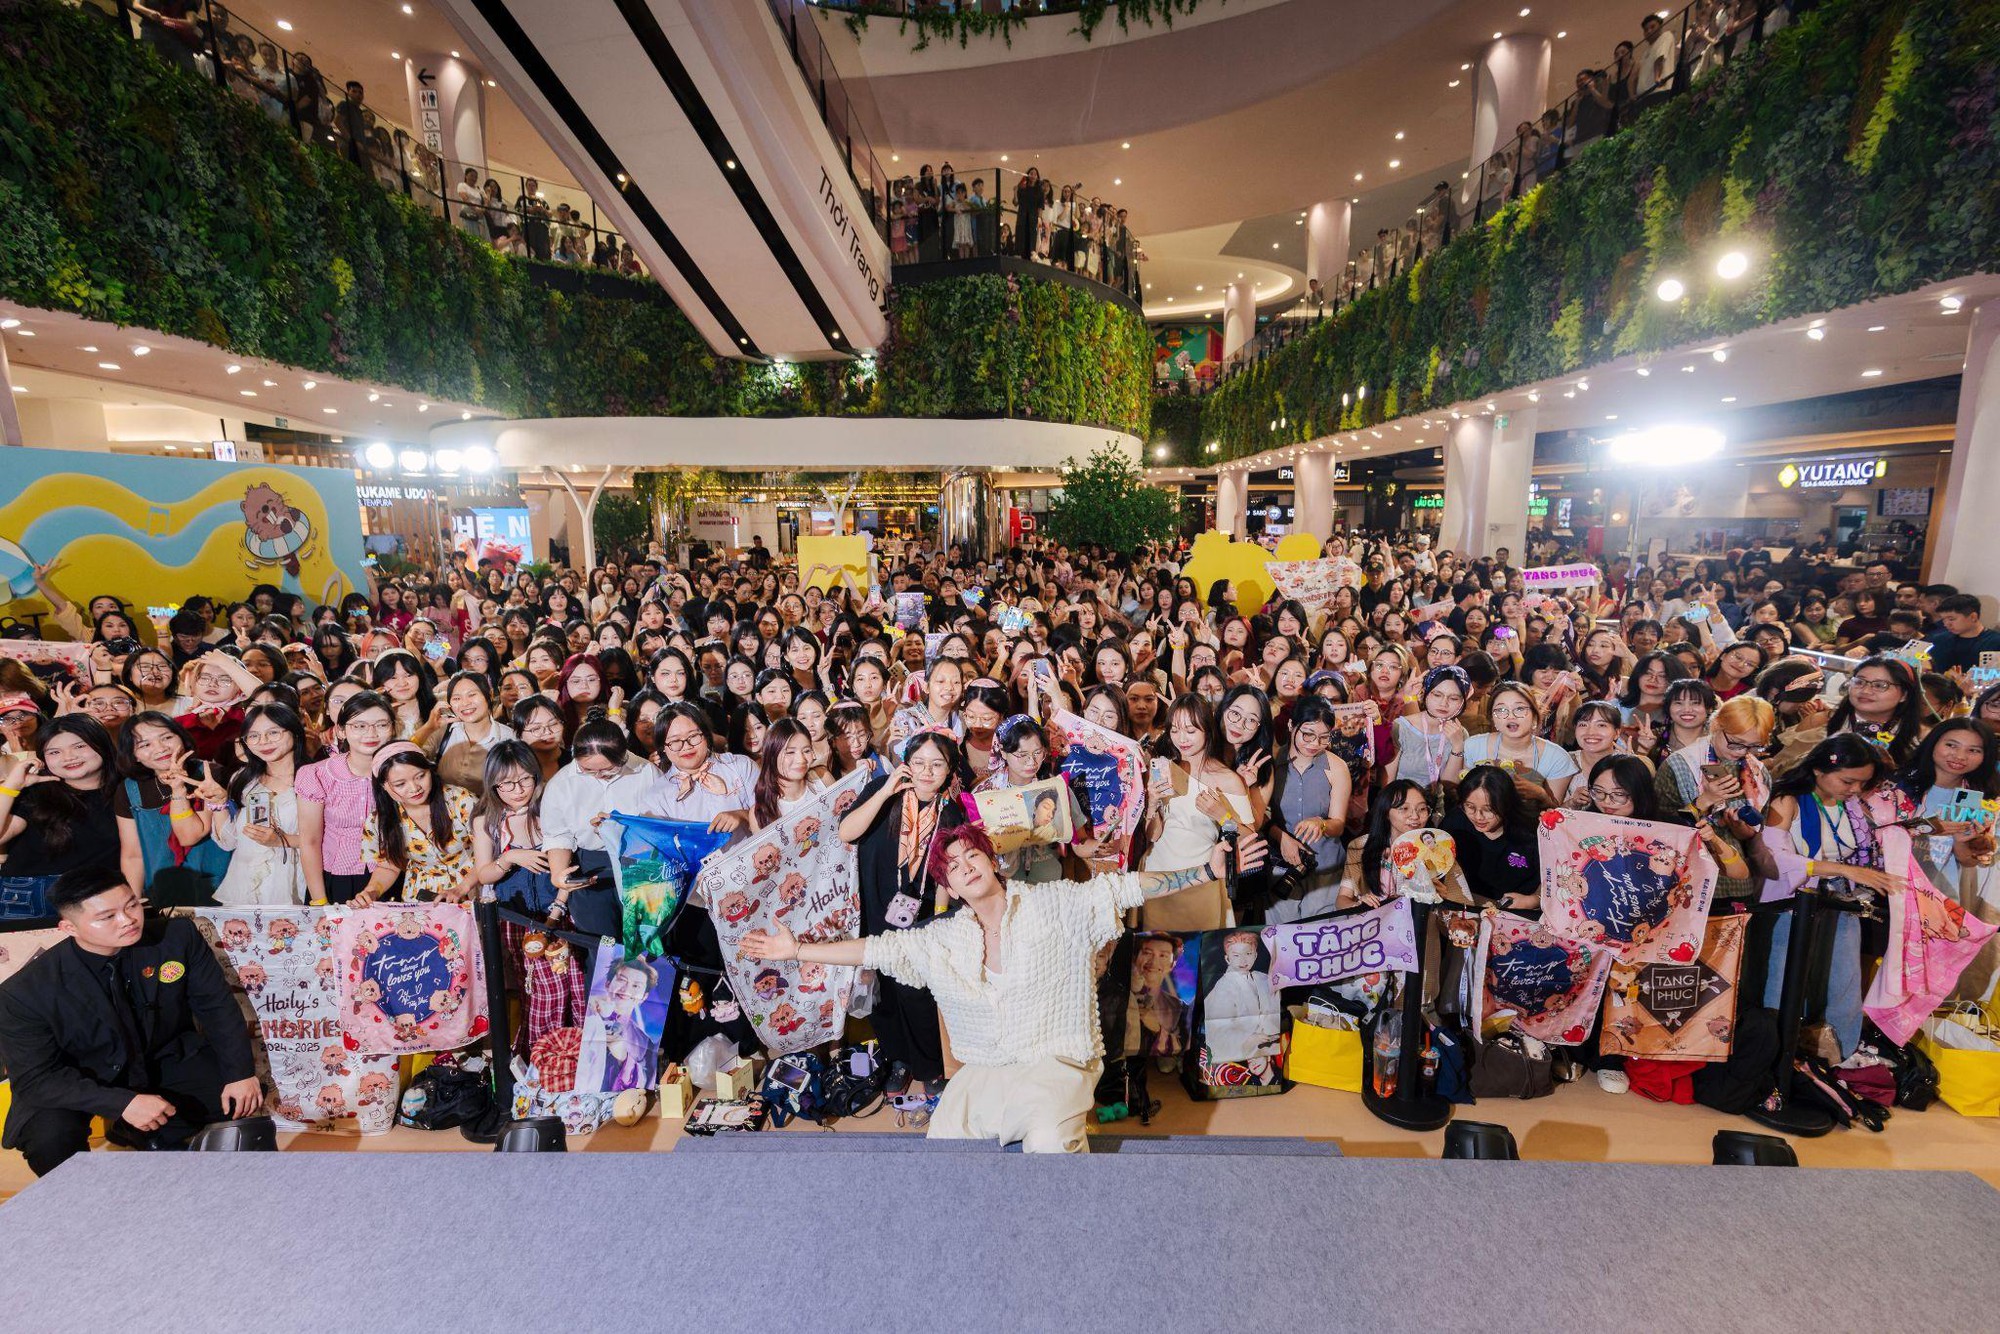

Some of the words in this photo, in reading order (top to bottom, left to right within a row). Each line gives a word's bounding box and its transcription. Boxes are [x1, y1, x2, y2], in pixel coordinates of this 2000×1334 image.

[819, 165, 849, 237] Thời
[849, 226, 880, 302] Trang
[1798, 461, 1876, 481] YUTANG
[1293, 917, 1381, 957] TĂNG
[1295, 940, 1386, 981] PHÚC
[387, 971, 413, 986] loves
[414, 965, 430, 979] you
[1510, 975, 1535, 986] loves
[1536, 973, 1554, 986] you
[1655, 975, 1695, 987] TANG
[257, 990, 319, 1018] Haily's
[1657, 989, 1693, 1001] PHUC
[249, 1018, 343, 1040] EMORIES
